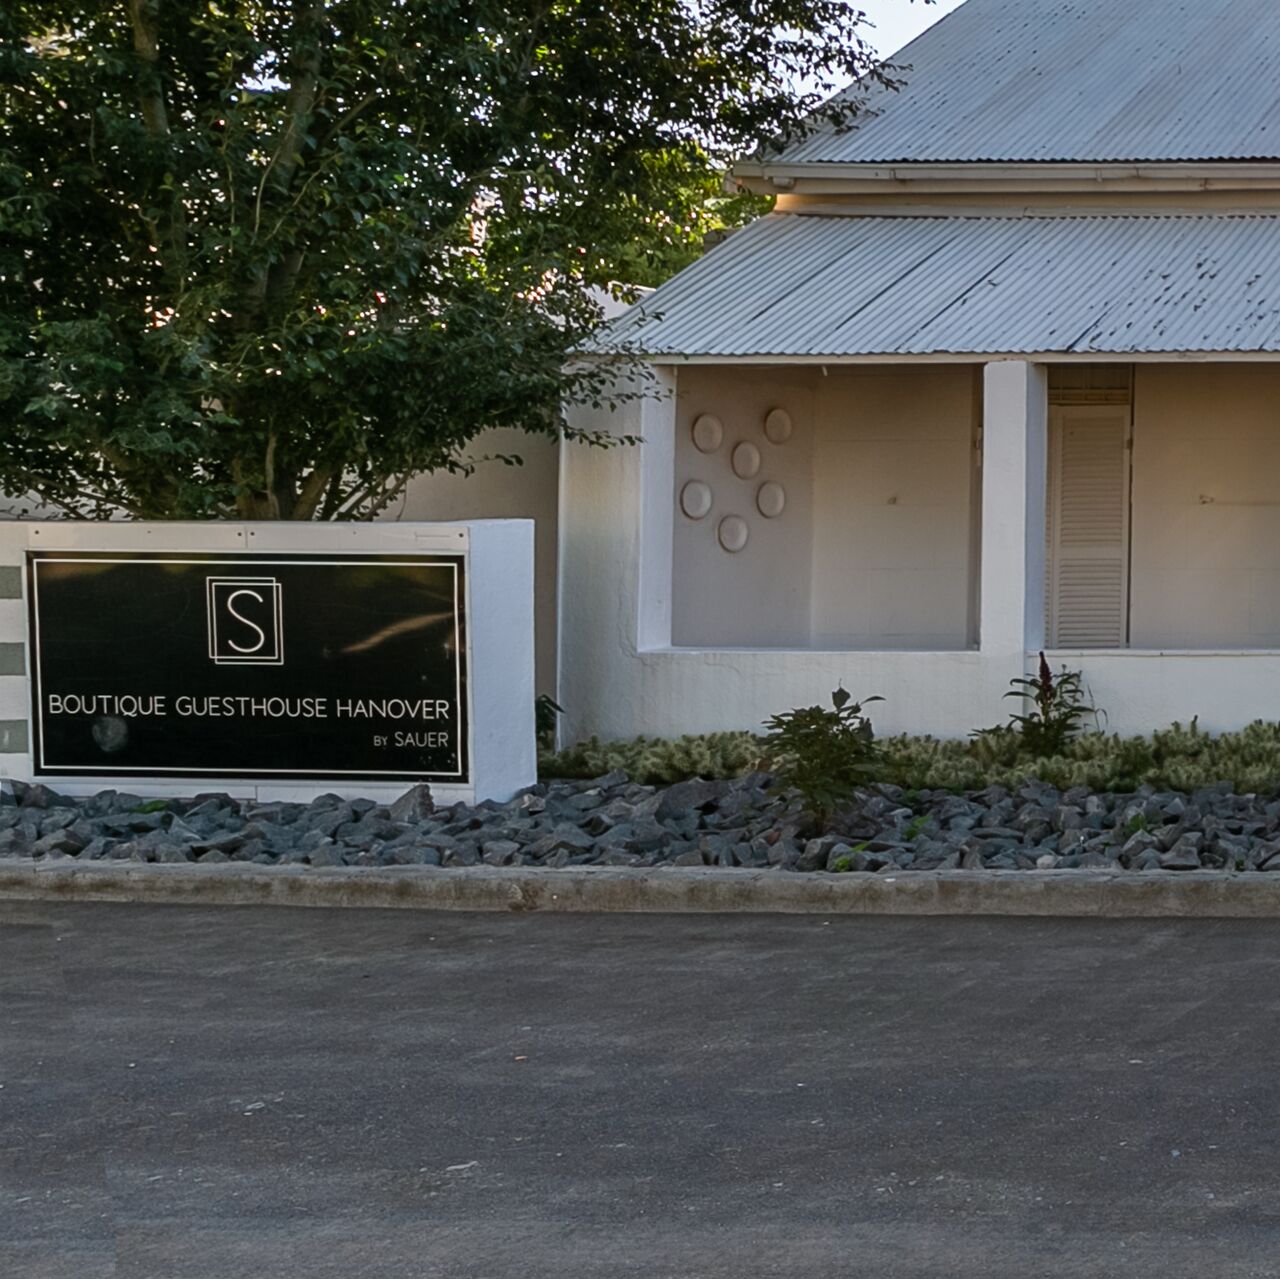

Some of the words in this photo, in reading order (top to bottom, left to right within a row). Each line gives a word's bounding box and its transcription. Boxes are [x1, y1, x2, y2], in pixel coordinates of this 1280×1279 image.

[227, 589, 265, 653] S
[49, 694, 167, 718] BOUTIQUE
[175, 696, 328, 718] GUESTHOUSE
[336, 698, 450, 720] HANOVER
[373, 734, 388, 747] BY
[394, 731, 449, 748] SAUER
